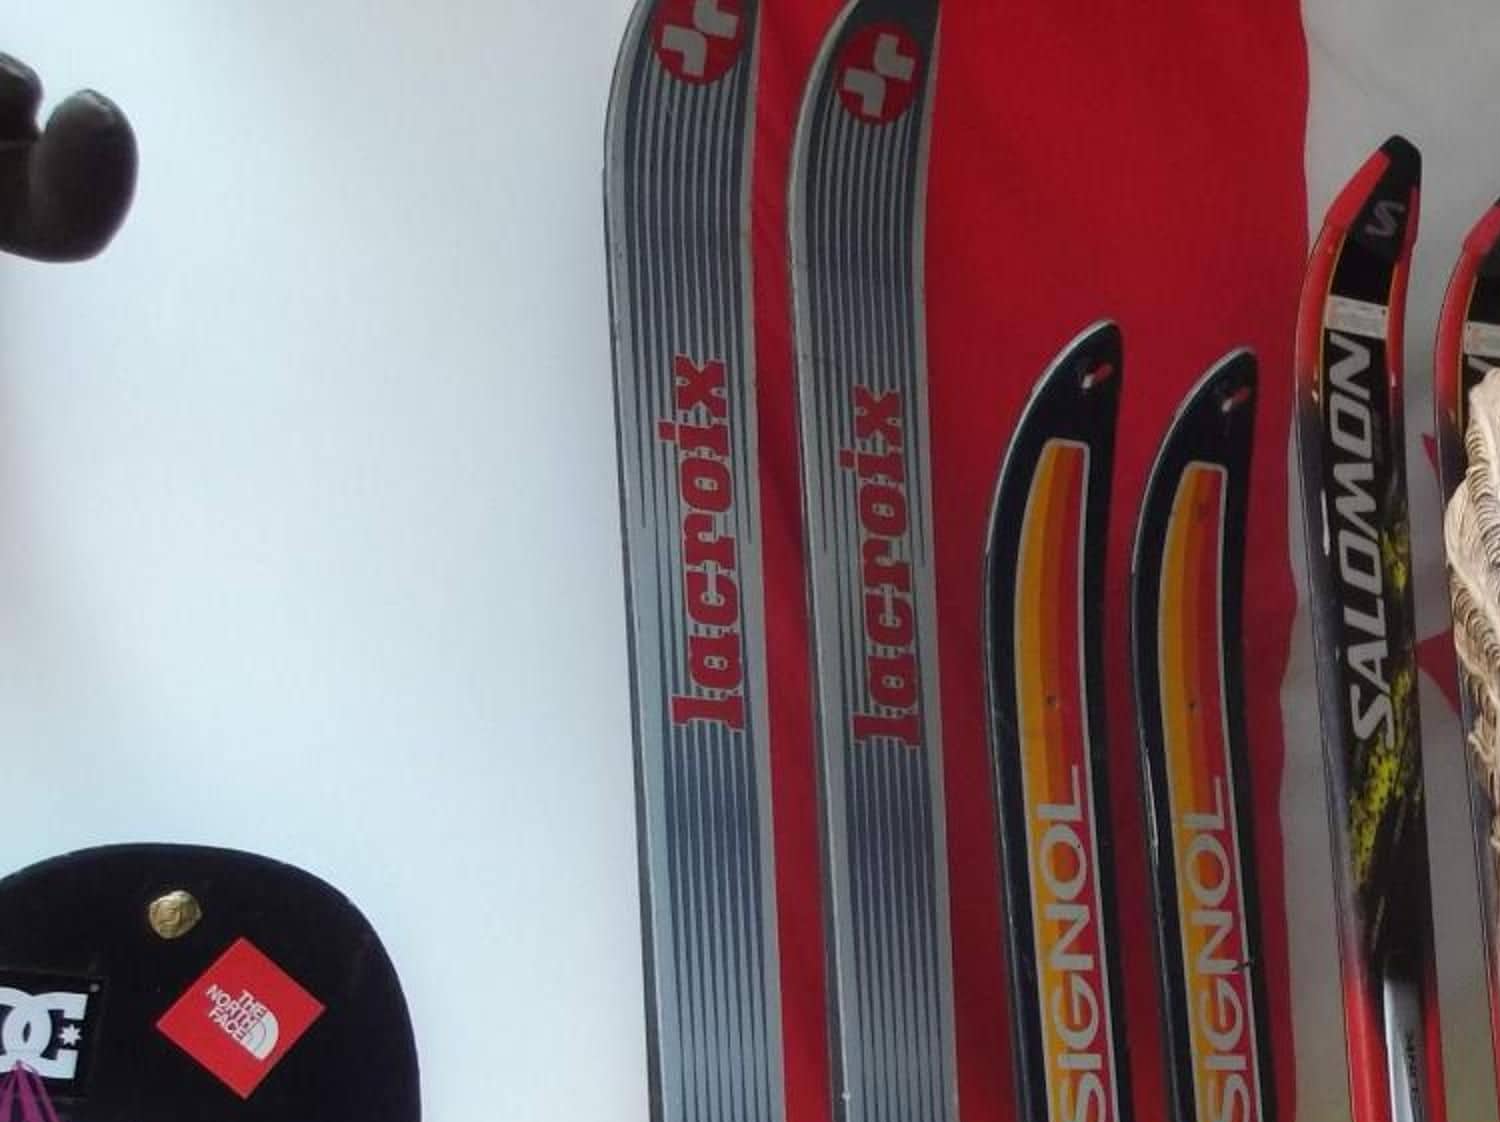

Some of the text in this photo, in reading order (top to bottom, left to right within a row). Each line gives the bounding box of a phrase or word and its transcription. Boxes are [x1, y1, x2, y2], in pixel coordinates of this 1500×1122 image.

[658, 353, 745, 733] lacroix
[840, 384, 922, 751] lacroix
[1328, 331, 1395, 750] SALOMON
[205, 984, 258, 1031] NORTH
[208, 1006, 247, 1041] FACE
[239, 988, 269, 1018] THE
